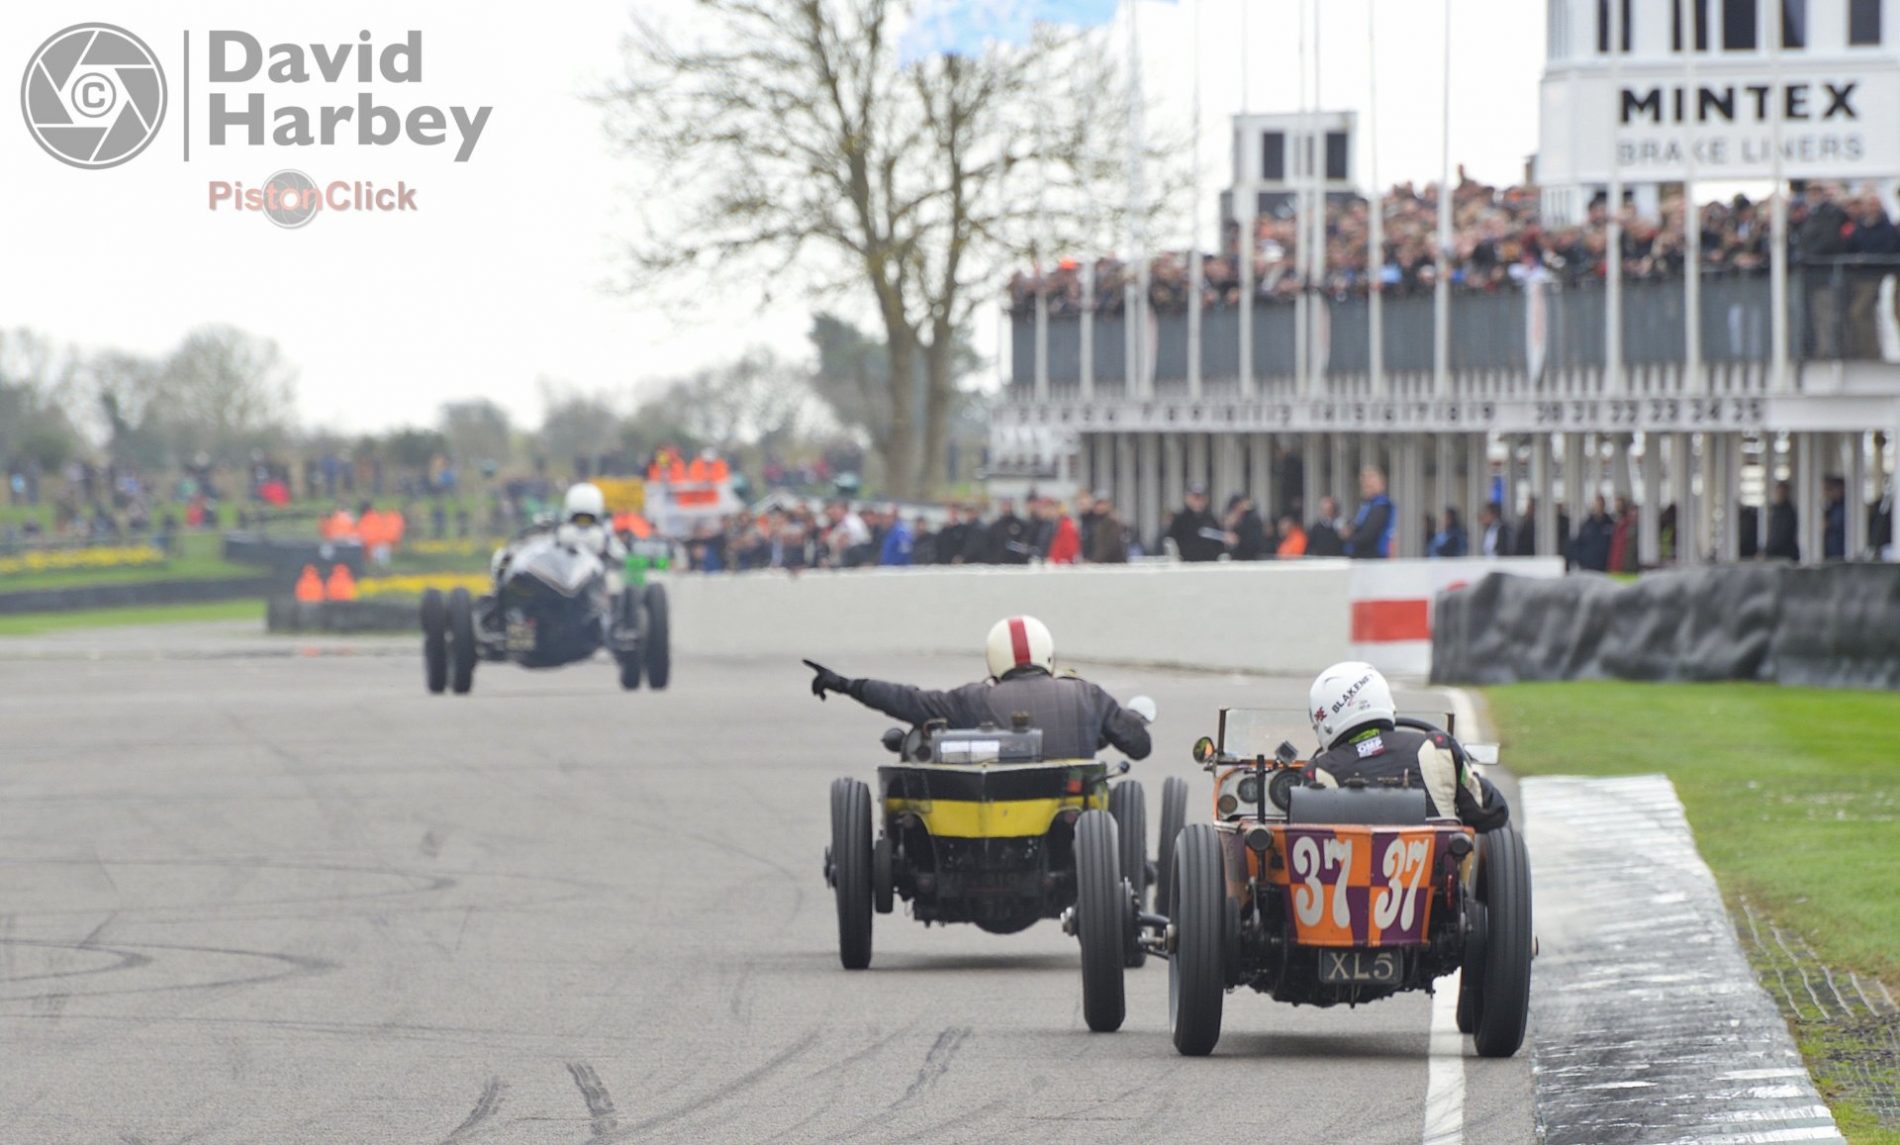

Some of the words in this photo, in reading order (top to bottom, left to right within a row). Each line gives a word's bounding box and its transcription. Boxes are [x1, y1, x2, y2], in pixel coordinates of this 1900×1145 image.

[1620, 82, 1858, 123] MINTEX
[1535, 400, 1563, 422] 20
[1572, 400, 1598, 422] 21
[1609, 400, 1639, 422] 22
[1648, 400, 1680, 422] 23
[1690, 400, 1722, 422] 24
[1732, 400, 1766, 422] 25
[1293, 836, 1353, 929] 37
[1374, 837, 1429, 932] 37
[1329, 952, 1394, 981] XL5
